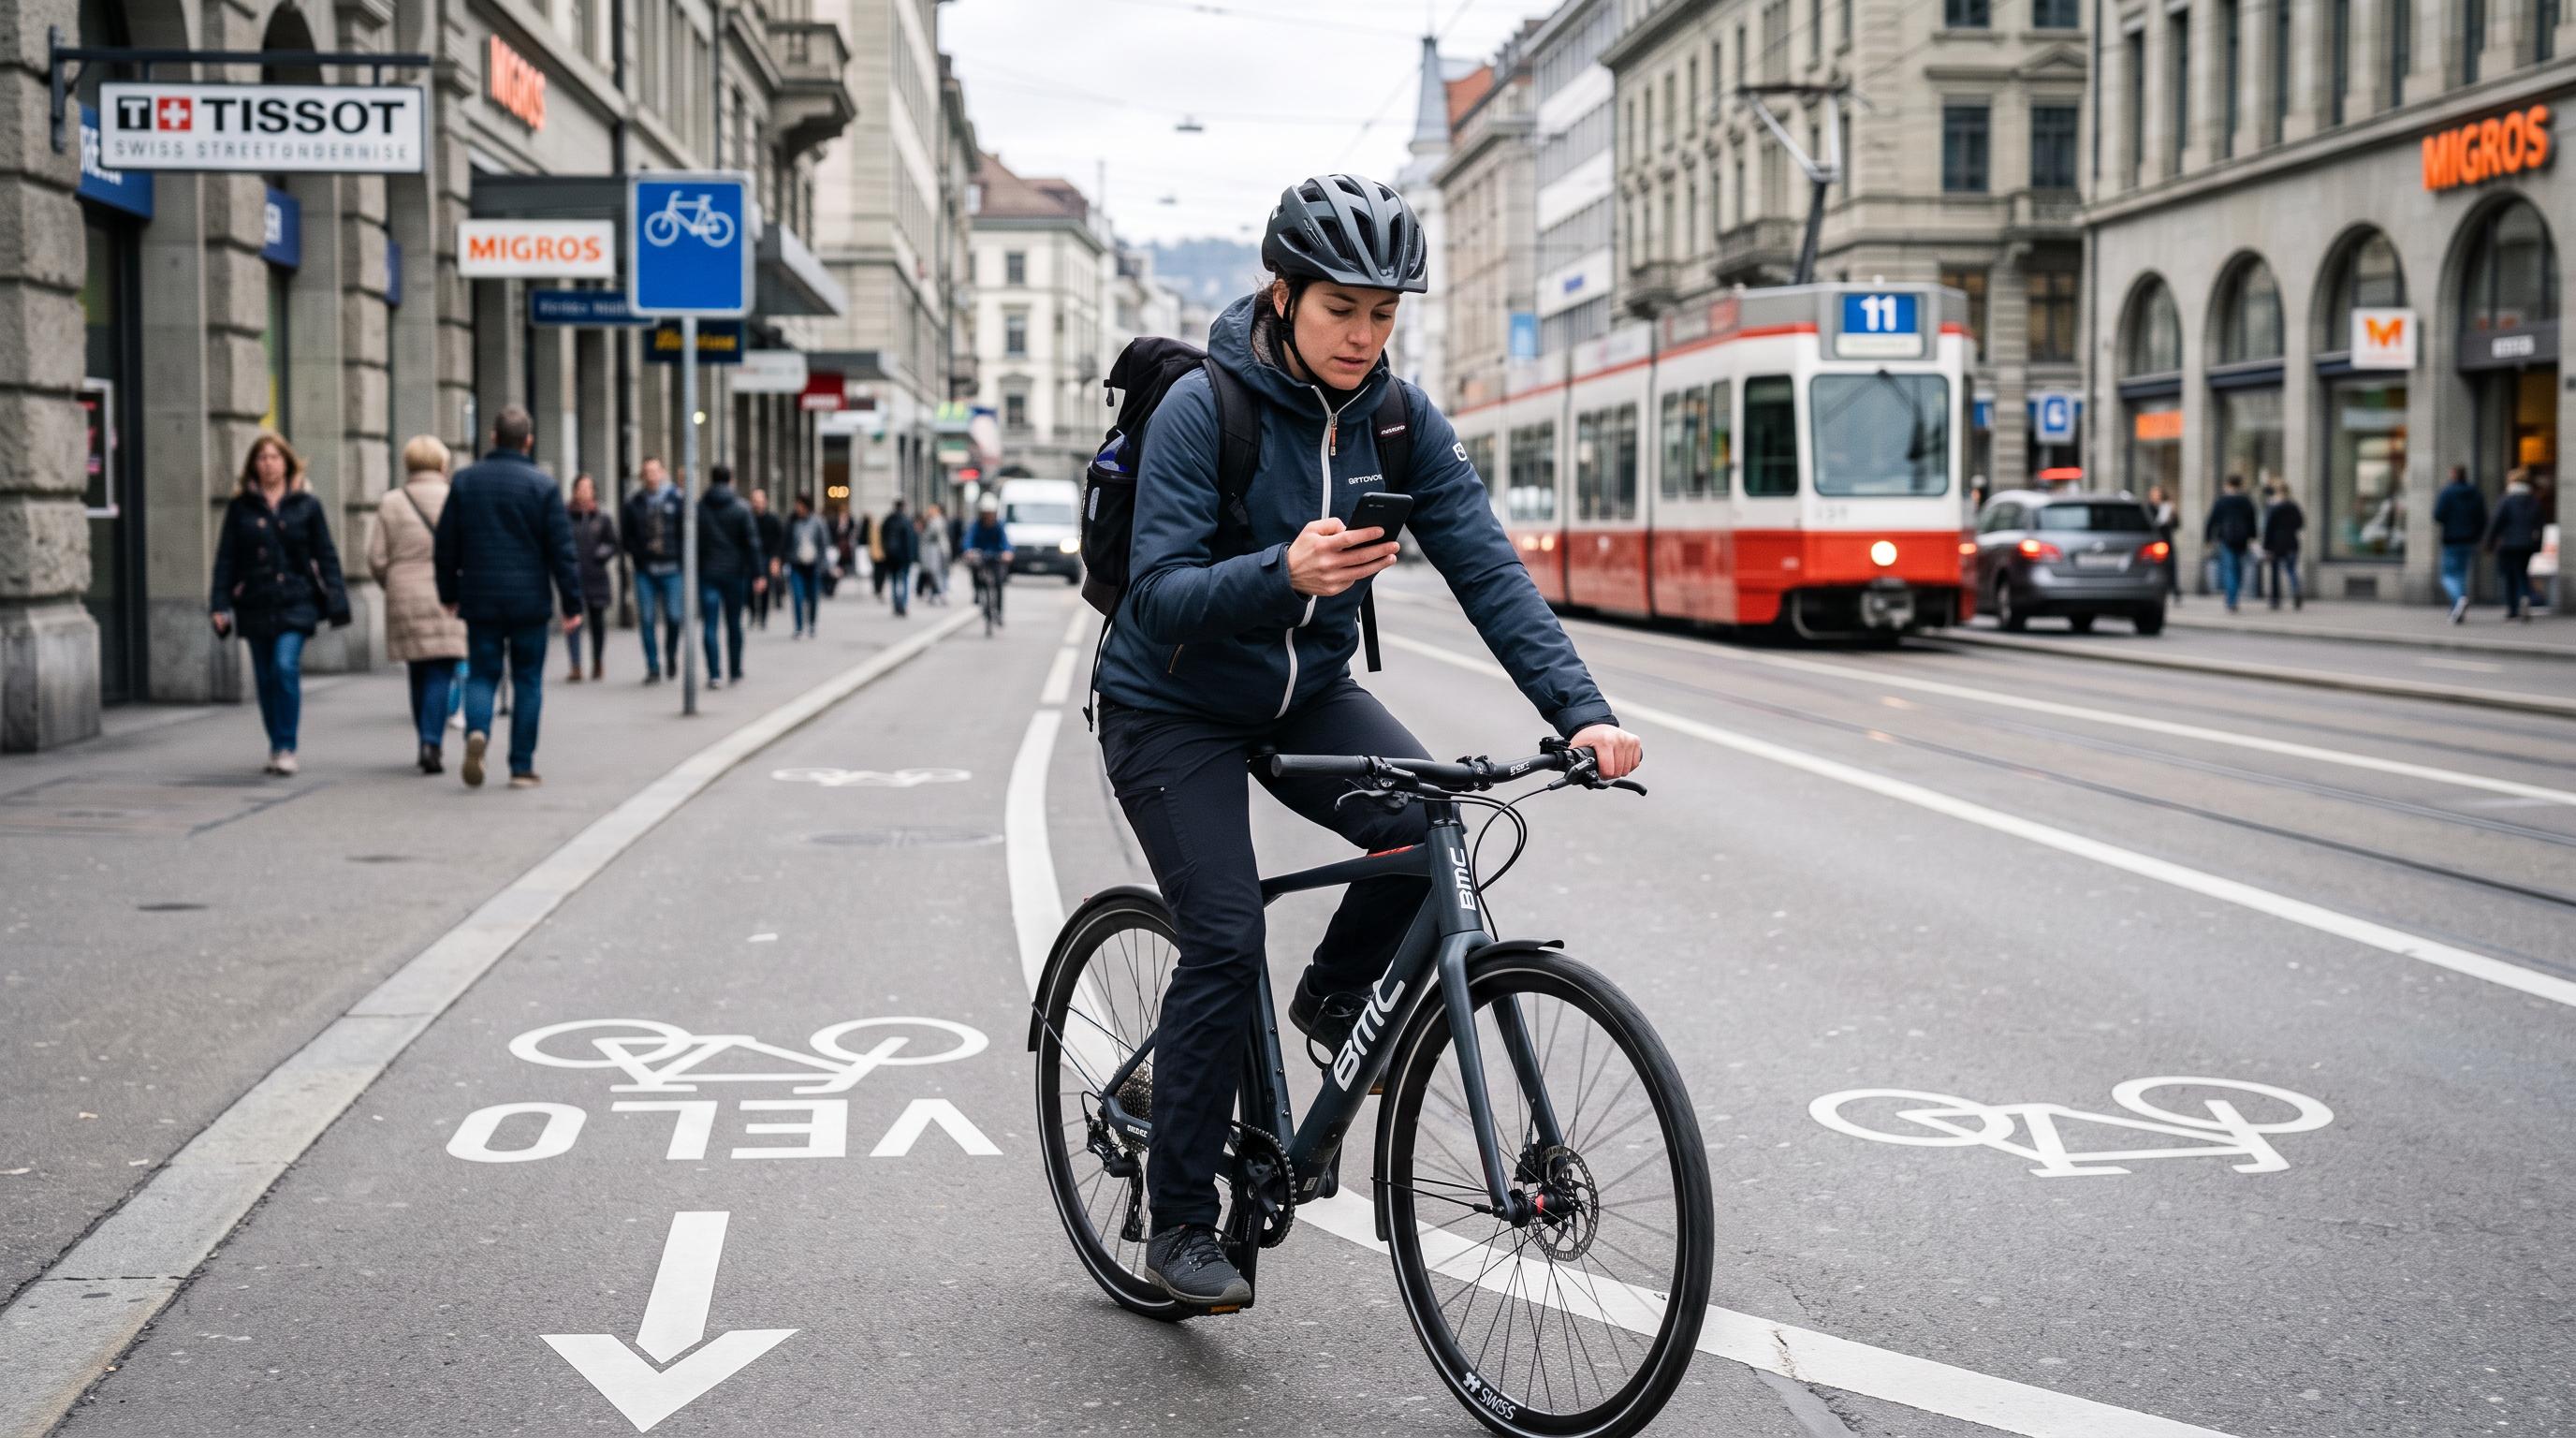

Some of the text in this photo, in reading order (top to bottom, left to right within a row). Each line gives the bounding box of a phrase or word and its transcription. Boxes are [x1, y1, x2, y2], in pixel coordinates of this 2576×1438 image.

[201, 97, 405, 134] TISSOT
[114, 139, 184, 158] SWISS
[2422, 104, 2549, 191] MIGROS
[468, 234, 603, 263] MIGROS
[1860, 294, 1897, 331] 11
[1449, 846, 1477, 911] BMC
[1333, 958, 1406, 1093] BMC
[446, 1098, 1004, 1164] VELO
